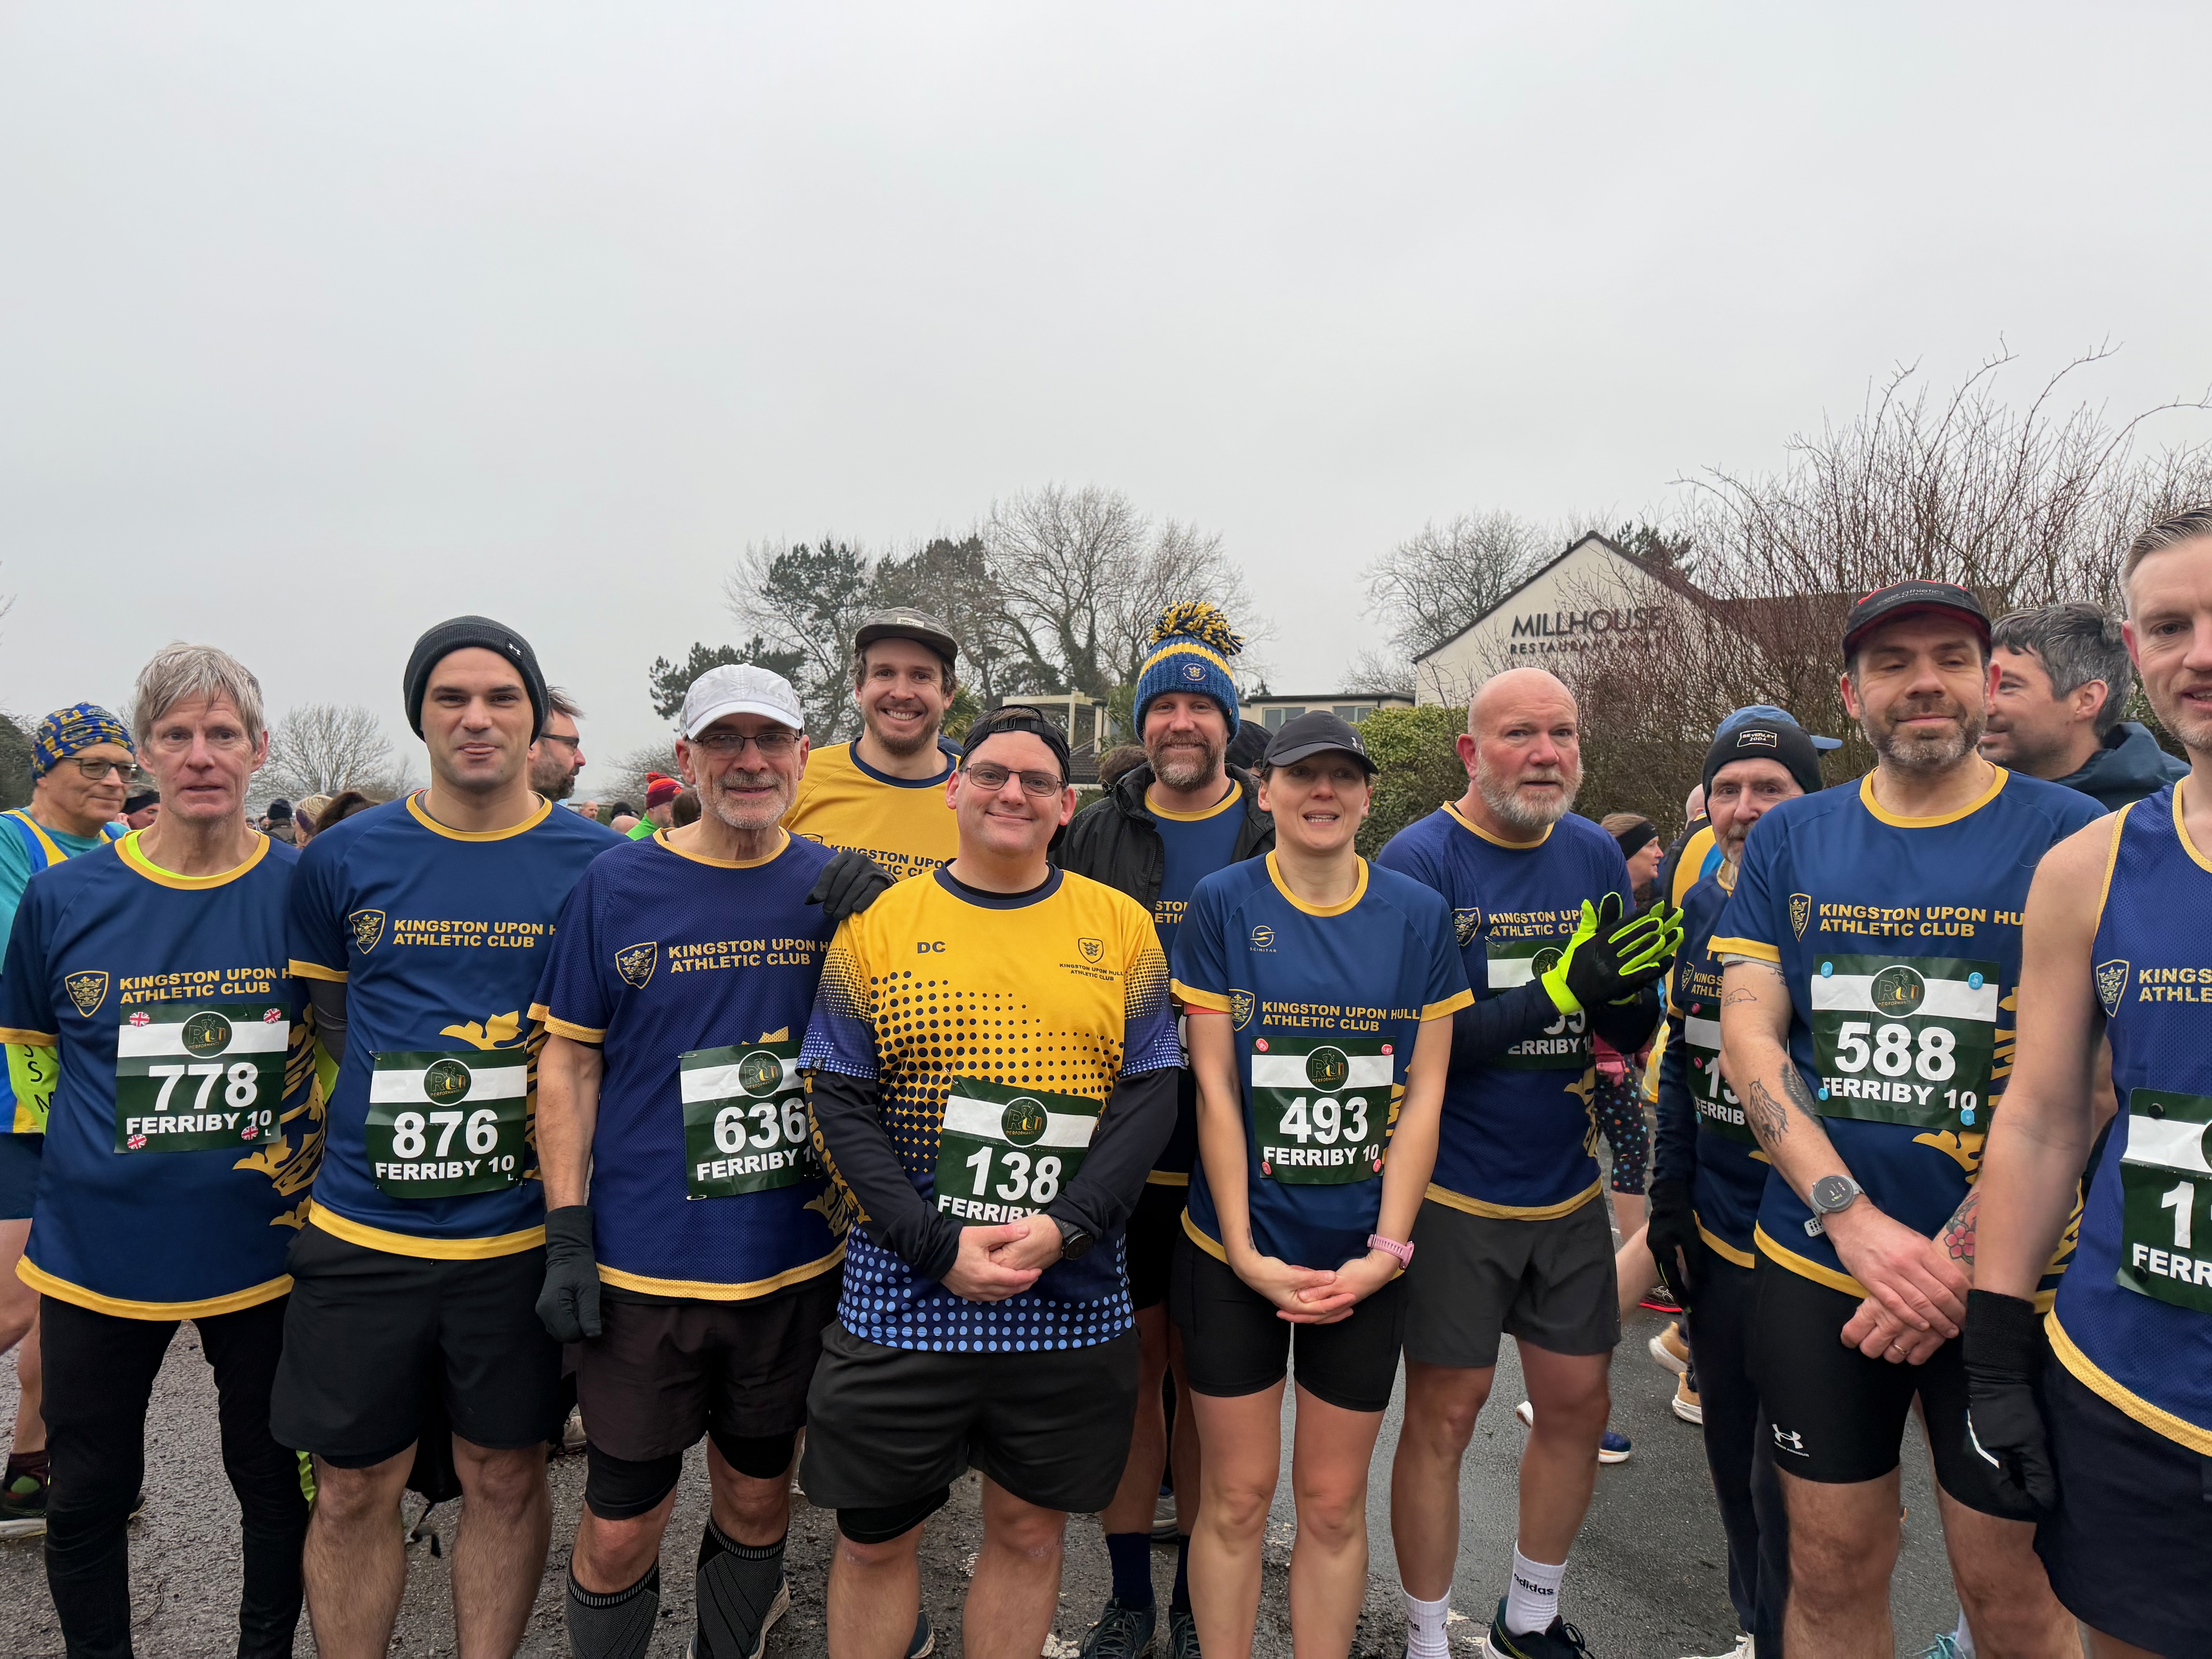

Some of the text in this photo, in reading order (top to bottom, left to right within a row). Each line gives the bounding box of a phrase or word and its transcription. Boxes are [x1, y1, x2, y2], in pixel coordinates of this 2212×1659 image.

[1511, 606, 1664, 637] MILLHOUSE
[1489, 912, 1556, 924] KINGSTON
[1819, 903, 2024, 927] KINGSTON UPON HU
[393, 920, 557, 935] KINGSTON UPON H
[1489, 924, 1554, 937] ATHLETIC
[1819, 919, 1975, 937] ATHLETIC CLUB
[393, 934, 535, 948] ATHLETIC CLUB
[668, 939, 766, 958] KINGSTON
[772, 938, 816, 952] UPON
[917, 941, 946, 954] DC
[670, 952, 811, 973] ATHLETIC CLUB
[120, 970, 220, 990] KINGSTON
[227, 968, 276, 981] UPON
[1070, 970, 1098, 978] ATHLETIC
[120, 982, 271, 1003] ATHLETIC CLUB
[1262, 1001, 1420, 1020] KINGSTON UPON HULL
[1262, 1014, 1380, 1032] ATHLETIC CLUB
[1834, 1021, 1956, 1081] 588
[149, 1062, 258, 1111] 778
[1822, 1077, 1977, 1111] FERRIBY 10
[126, 1109, 272, 1135] FERRIBY 10
[714, 1097, 806, 1154] 636
[1279, 1097, 1368, 1145] 493
[392, 1109, 499, 1159] 876
[696, 1148, 799, 1182] FERRIBY
[1263, 1144, 1380, 1166] FERRIBY 10
[375, 1155, 515, 1181] FERRIBY 10
[966, 1147, 1062, 1204] 138
[1514, 1573, 1554, 1595] adidas
